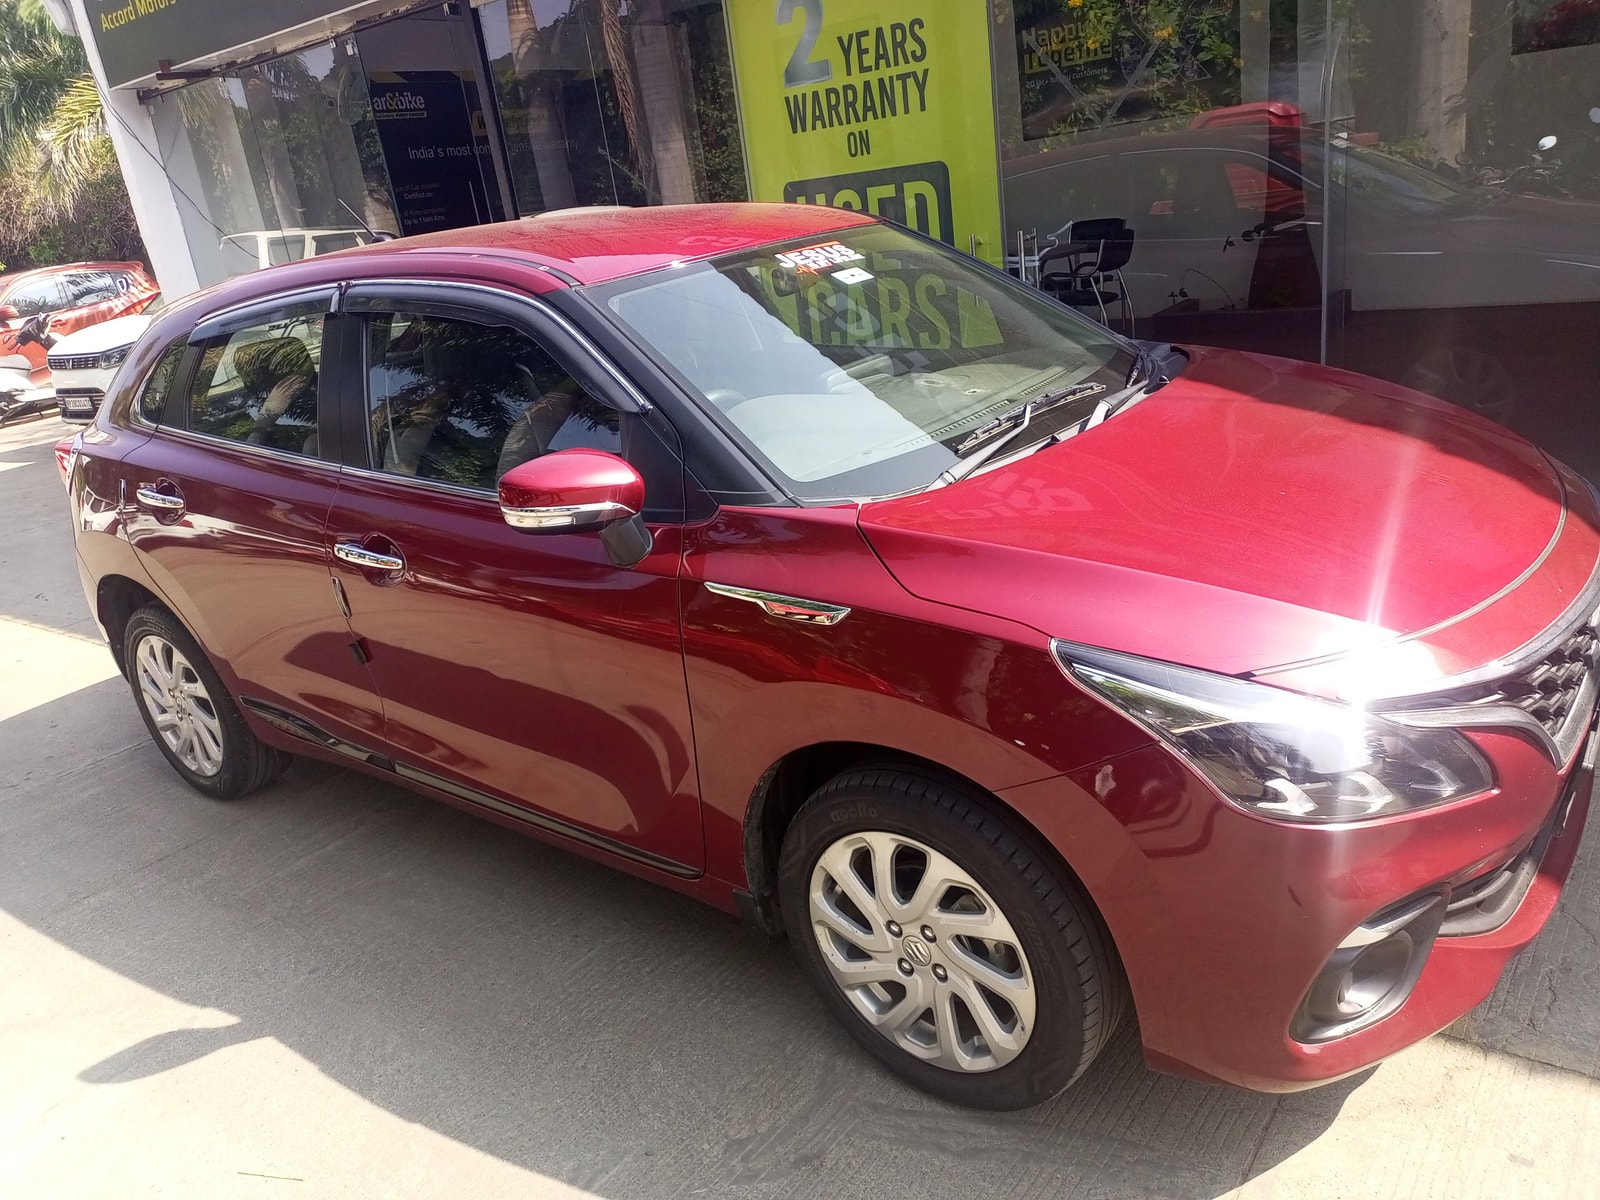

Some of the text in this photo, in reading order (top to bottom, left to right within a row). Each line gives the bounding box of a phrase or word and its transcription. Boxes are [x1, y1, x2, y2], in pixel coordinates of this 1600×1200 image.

[100, 0, 136, 32] Accord
[775, 0, 927, 88] 2 YEARS
[784, 68, 929, 134] WARRANTY
[407, 145, 444, 160] India's
[446, 144, 472, 157] most
[847, 129, 871, 158] ON
[774, 244, 856, 268] JESUS
[806, 273, 952, 350] CARS
